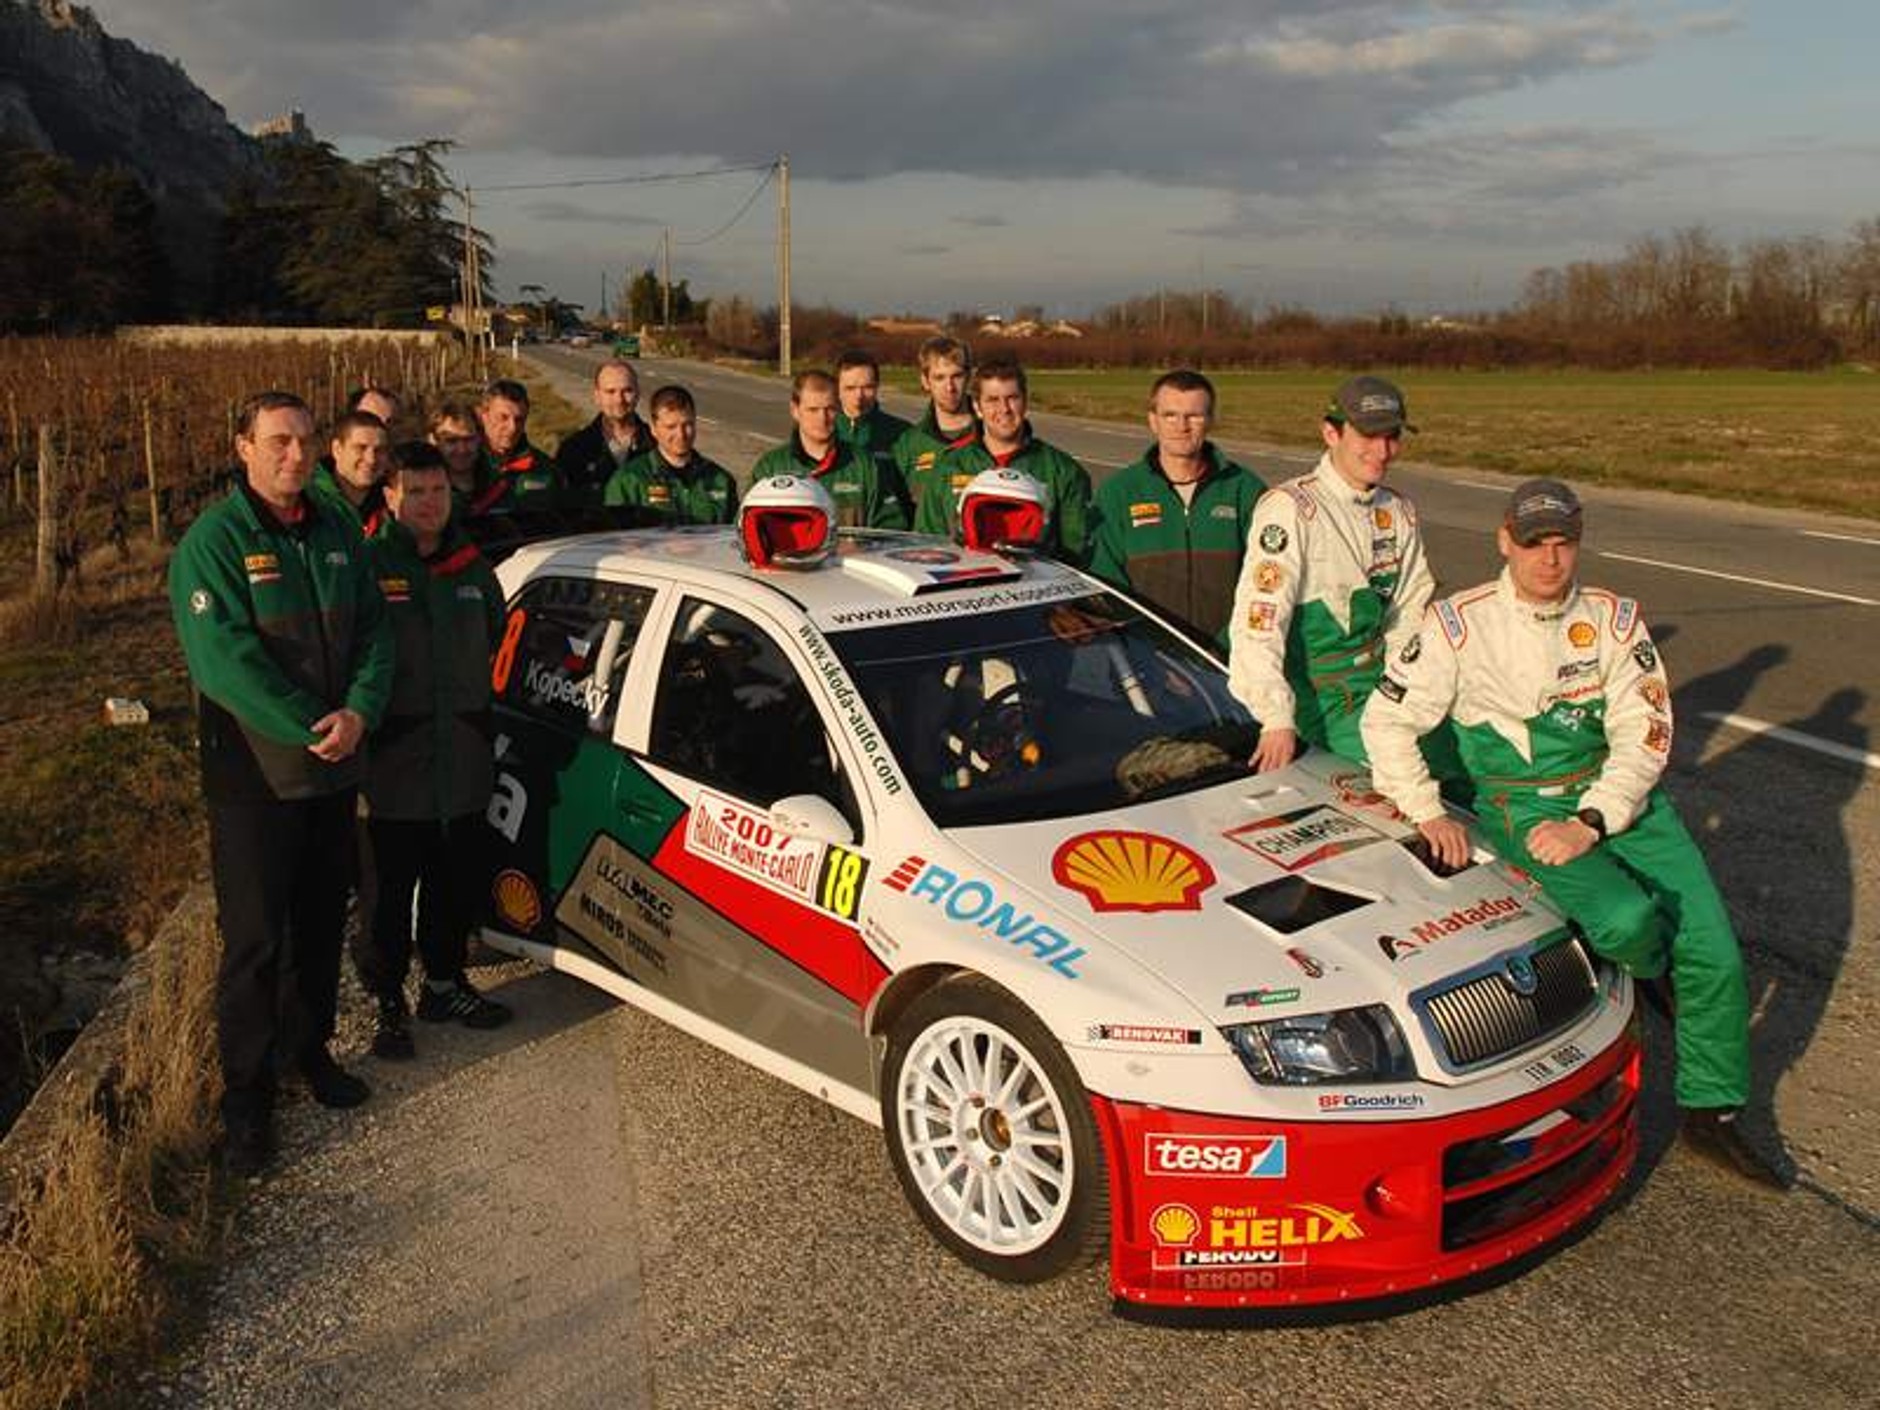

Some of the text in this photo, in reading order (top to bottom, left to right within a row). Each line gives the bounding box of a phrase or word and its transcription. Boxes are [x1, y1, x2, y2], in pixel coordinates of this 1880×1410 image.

[800, 625, 901, 796] www.skoda-auto.com
[824, 844, 862, 919] 18
[911, 864, 1087, 979] RONAL
[1414, 896, 1522, 944] Matador
[1318, 1093, 1424, 1108] BFGoodrich
[1156, 1140, 1242, 1171] tesa
[1210, 1203, 1365, 1247] HELIX
[1211, 1206, 1257, 1218] Shell
